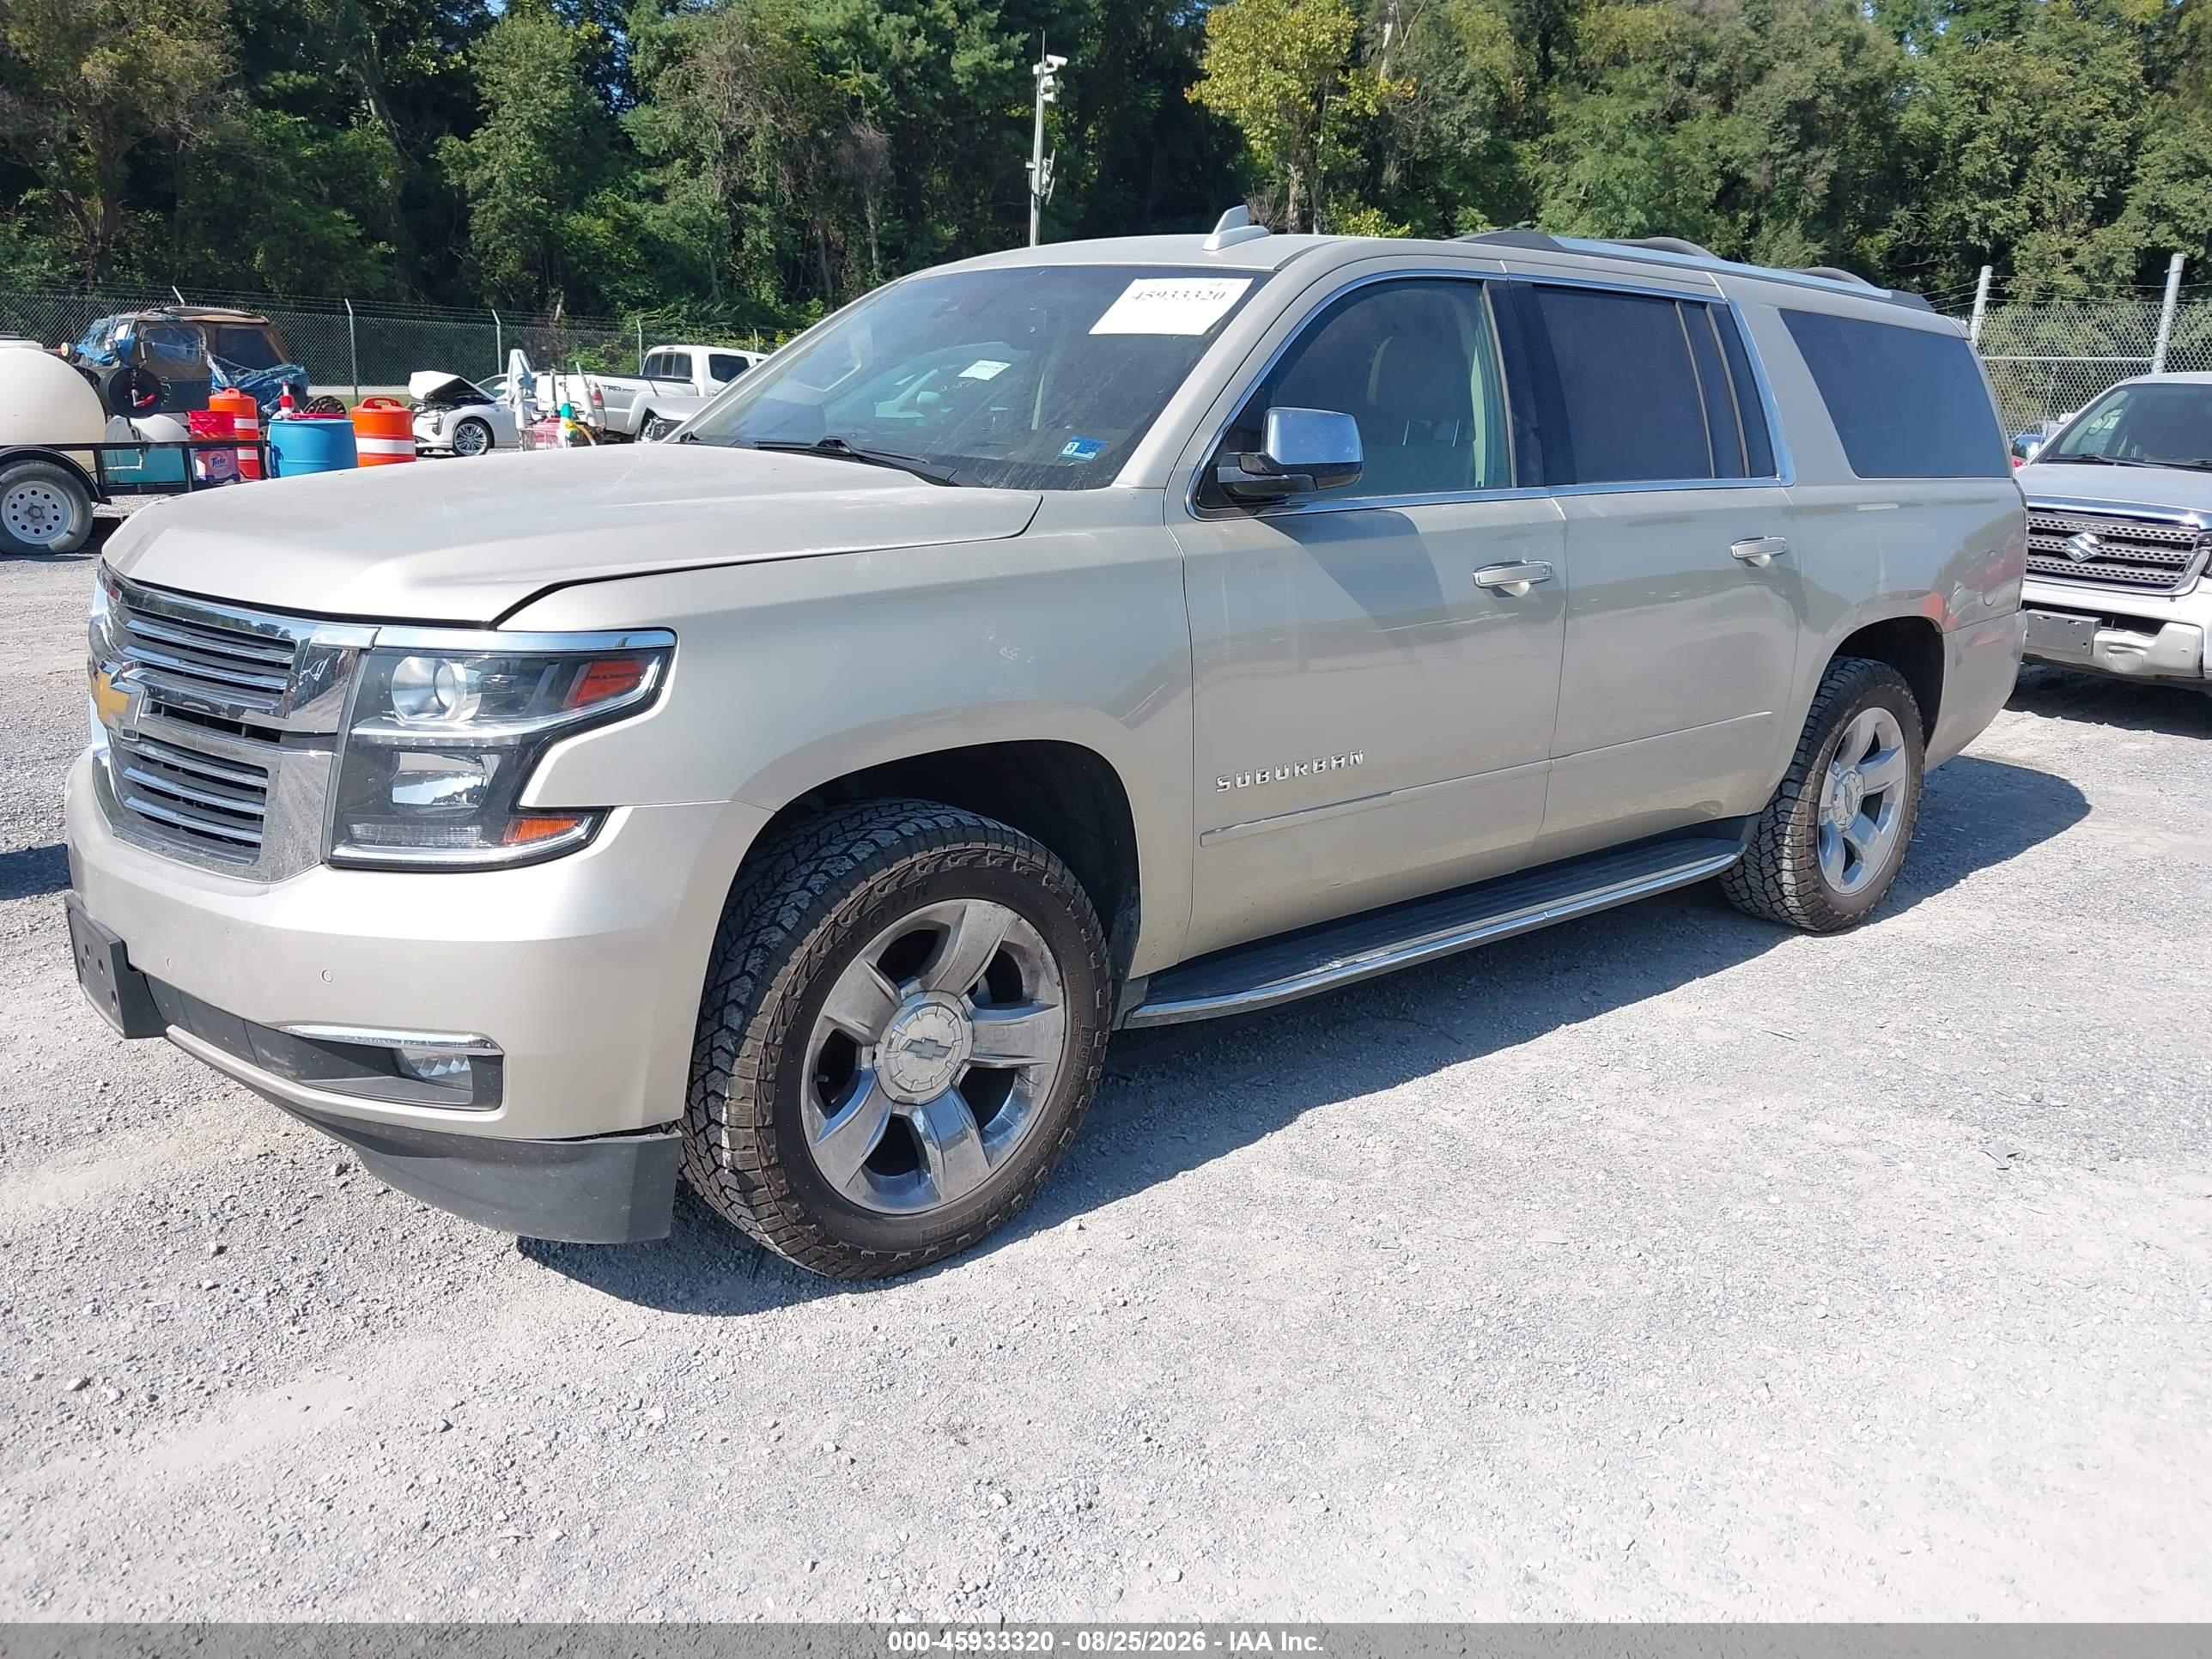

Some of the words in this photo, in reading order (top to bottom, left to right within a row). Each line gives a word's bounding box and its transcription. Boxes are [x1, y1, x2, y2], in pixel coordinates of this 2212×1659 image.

[1132, 289, 1227, 301] 45933320
[210, 458, 226, 468] Tide
[1215, 750, 1364, 793] SUBURBAN
